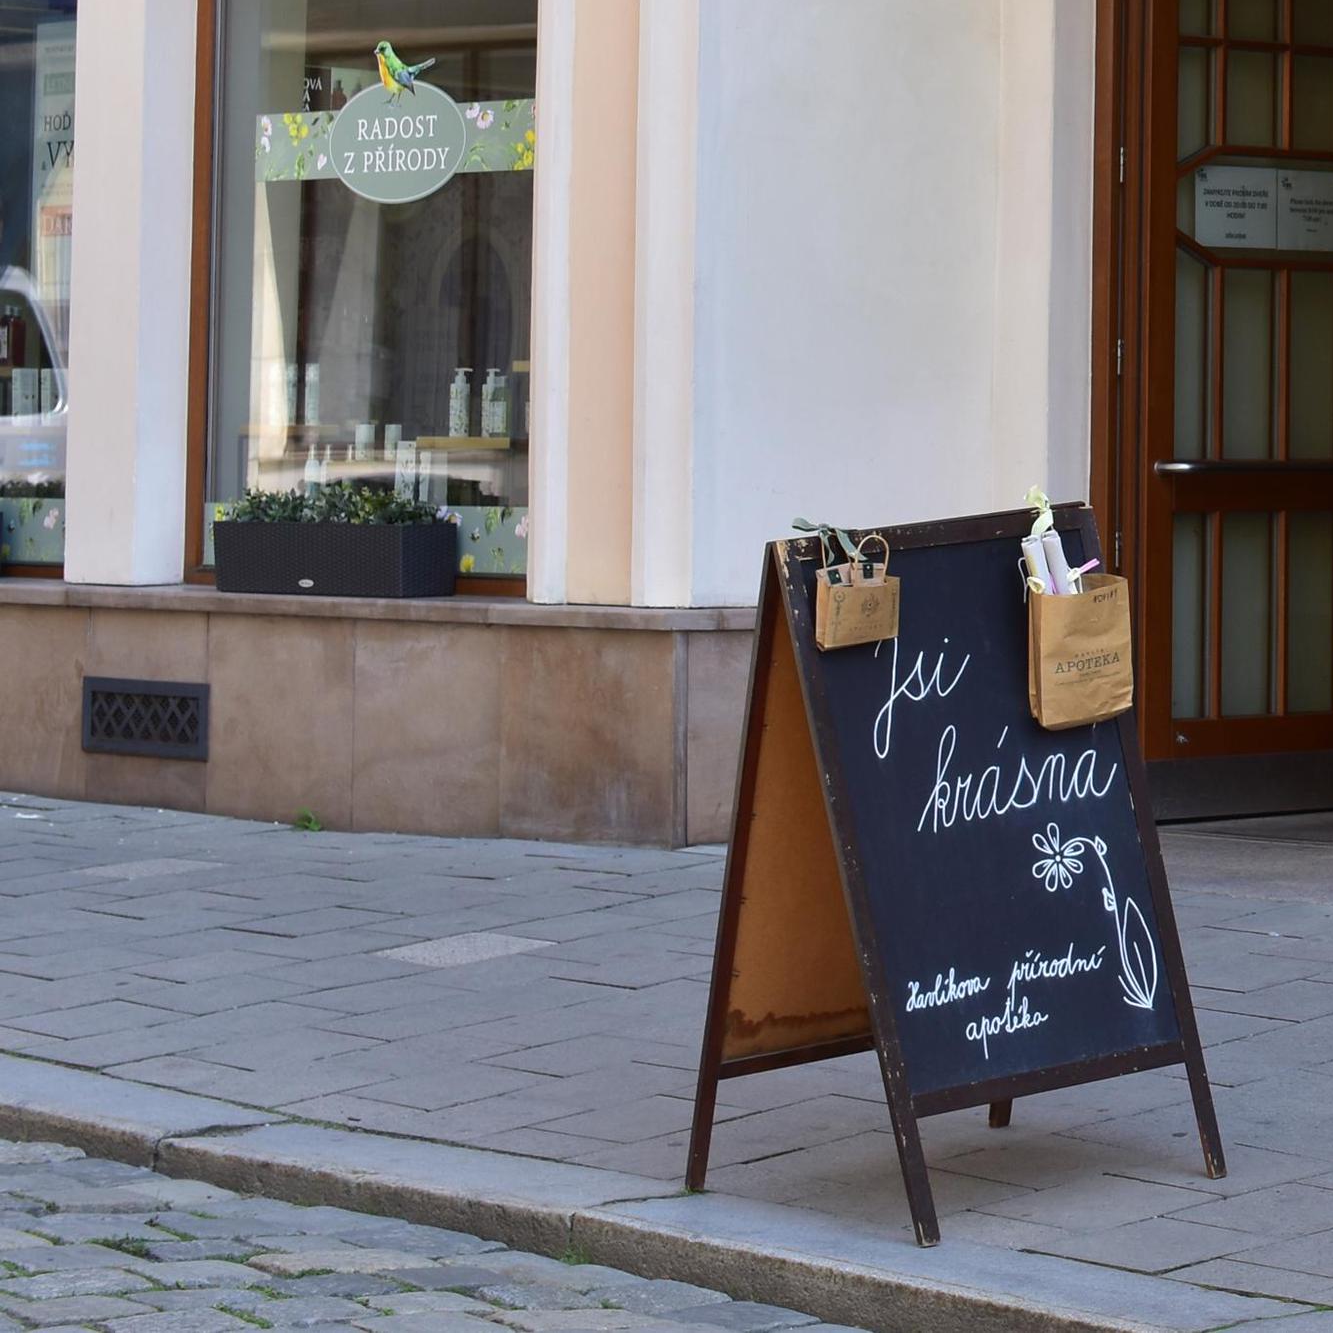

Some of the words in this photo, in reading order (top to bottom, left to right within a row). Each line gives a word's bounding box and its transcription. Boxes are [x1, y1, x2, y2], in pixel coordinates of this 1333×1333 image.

[357, 115, 438, 141] RADOST
[344, 152, 355, 174] Z
[363, 144, 450, 174] PŘÍRODY
[1054, 652, 1120, 674] APOTEKA
[905, 967, 991, 1012] Havlíkova
[1007, 942, 1106, 1011] přírodní
[965, 995, 1050, 1060] apotéka
